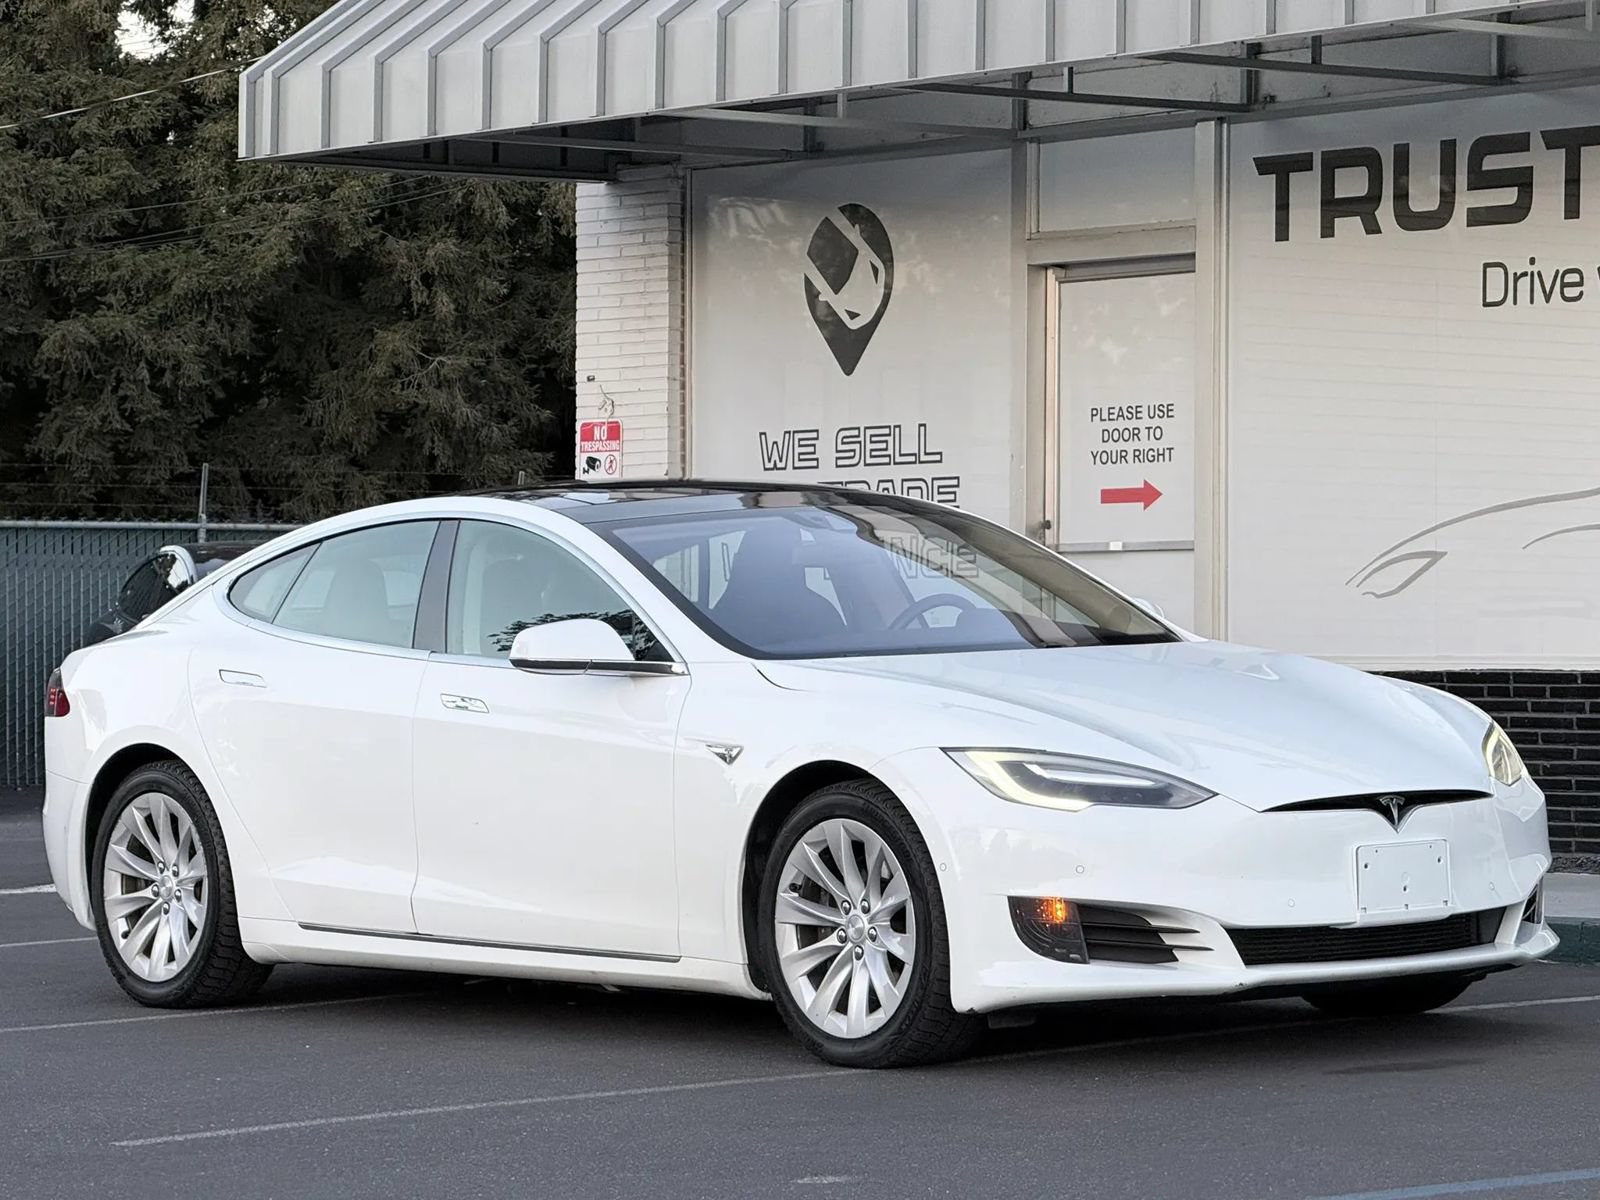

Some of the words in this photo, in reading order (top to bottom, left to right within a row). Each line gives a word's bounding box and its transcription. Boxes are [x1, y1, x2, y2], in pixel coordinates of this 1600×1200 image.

[1252, 125, 1600, 242] TRUST
[1482, 256, 1584, 308] Drive
[1090, 405, 1143, 423] PLEASE
[1147, 403, 1175, 420] USE
[593, 424, 608, 441] NO
[1101, 427, 1141, 443] DOOR
[1144, 425, 1163, 441] TO
[581, 440, 620, 452] TRESPASSING
[758, 429, 819, 472] WE
[835, 423, 943, 469] SELL
[1090, 449, 1129, 466] YOUR
[1132, 447, 1174, 464] RIGHT
